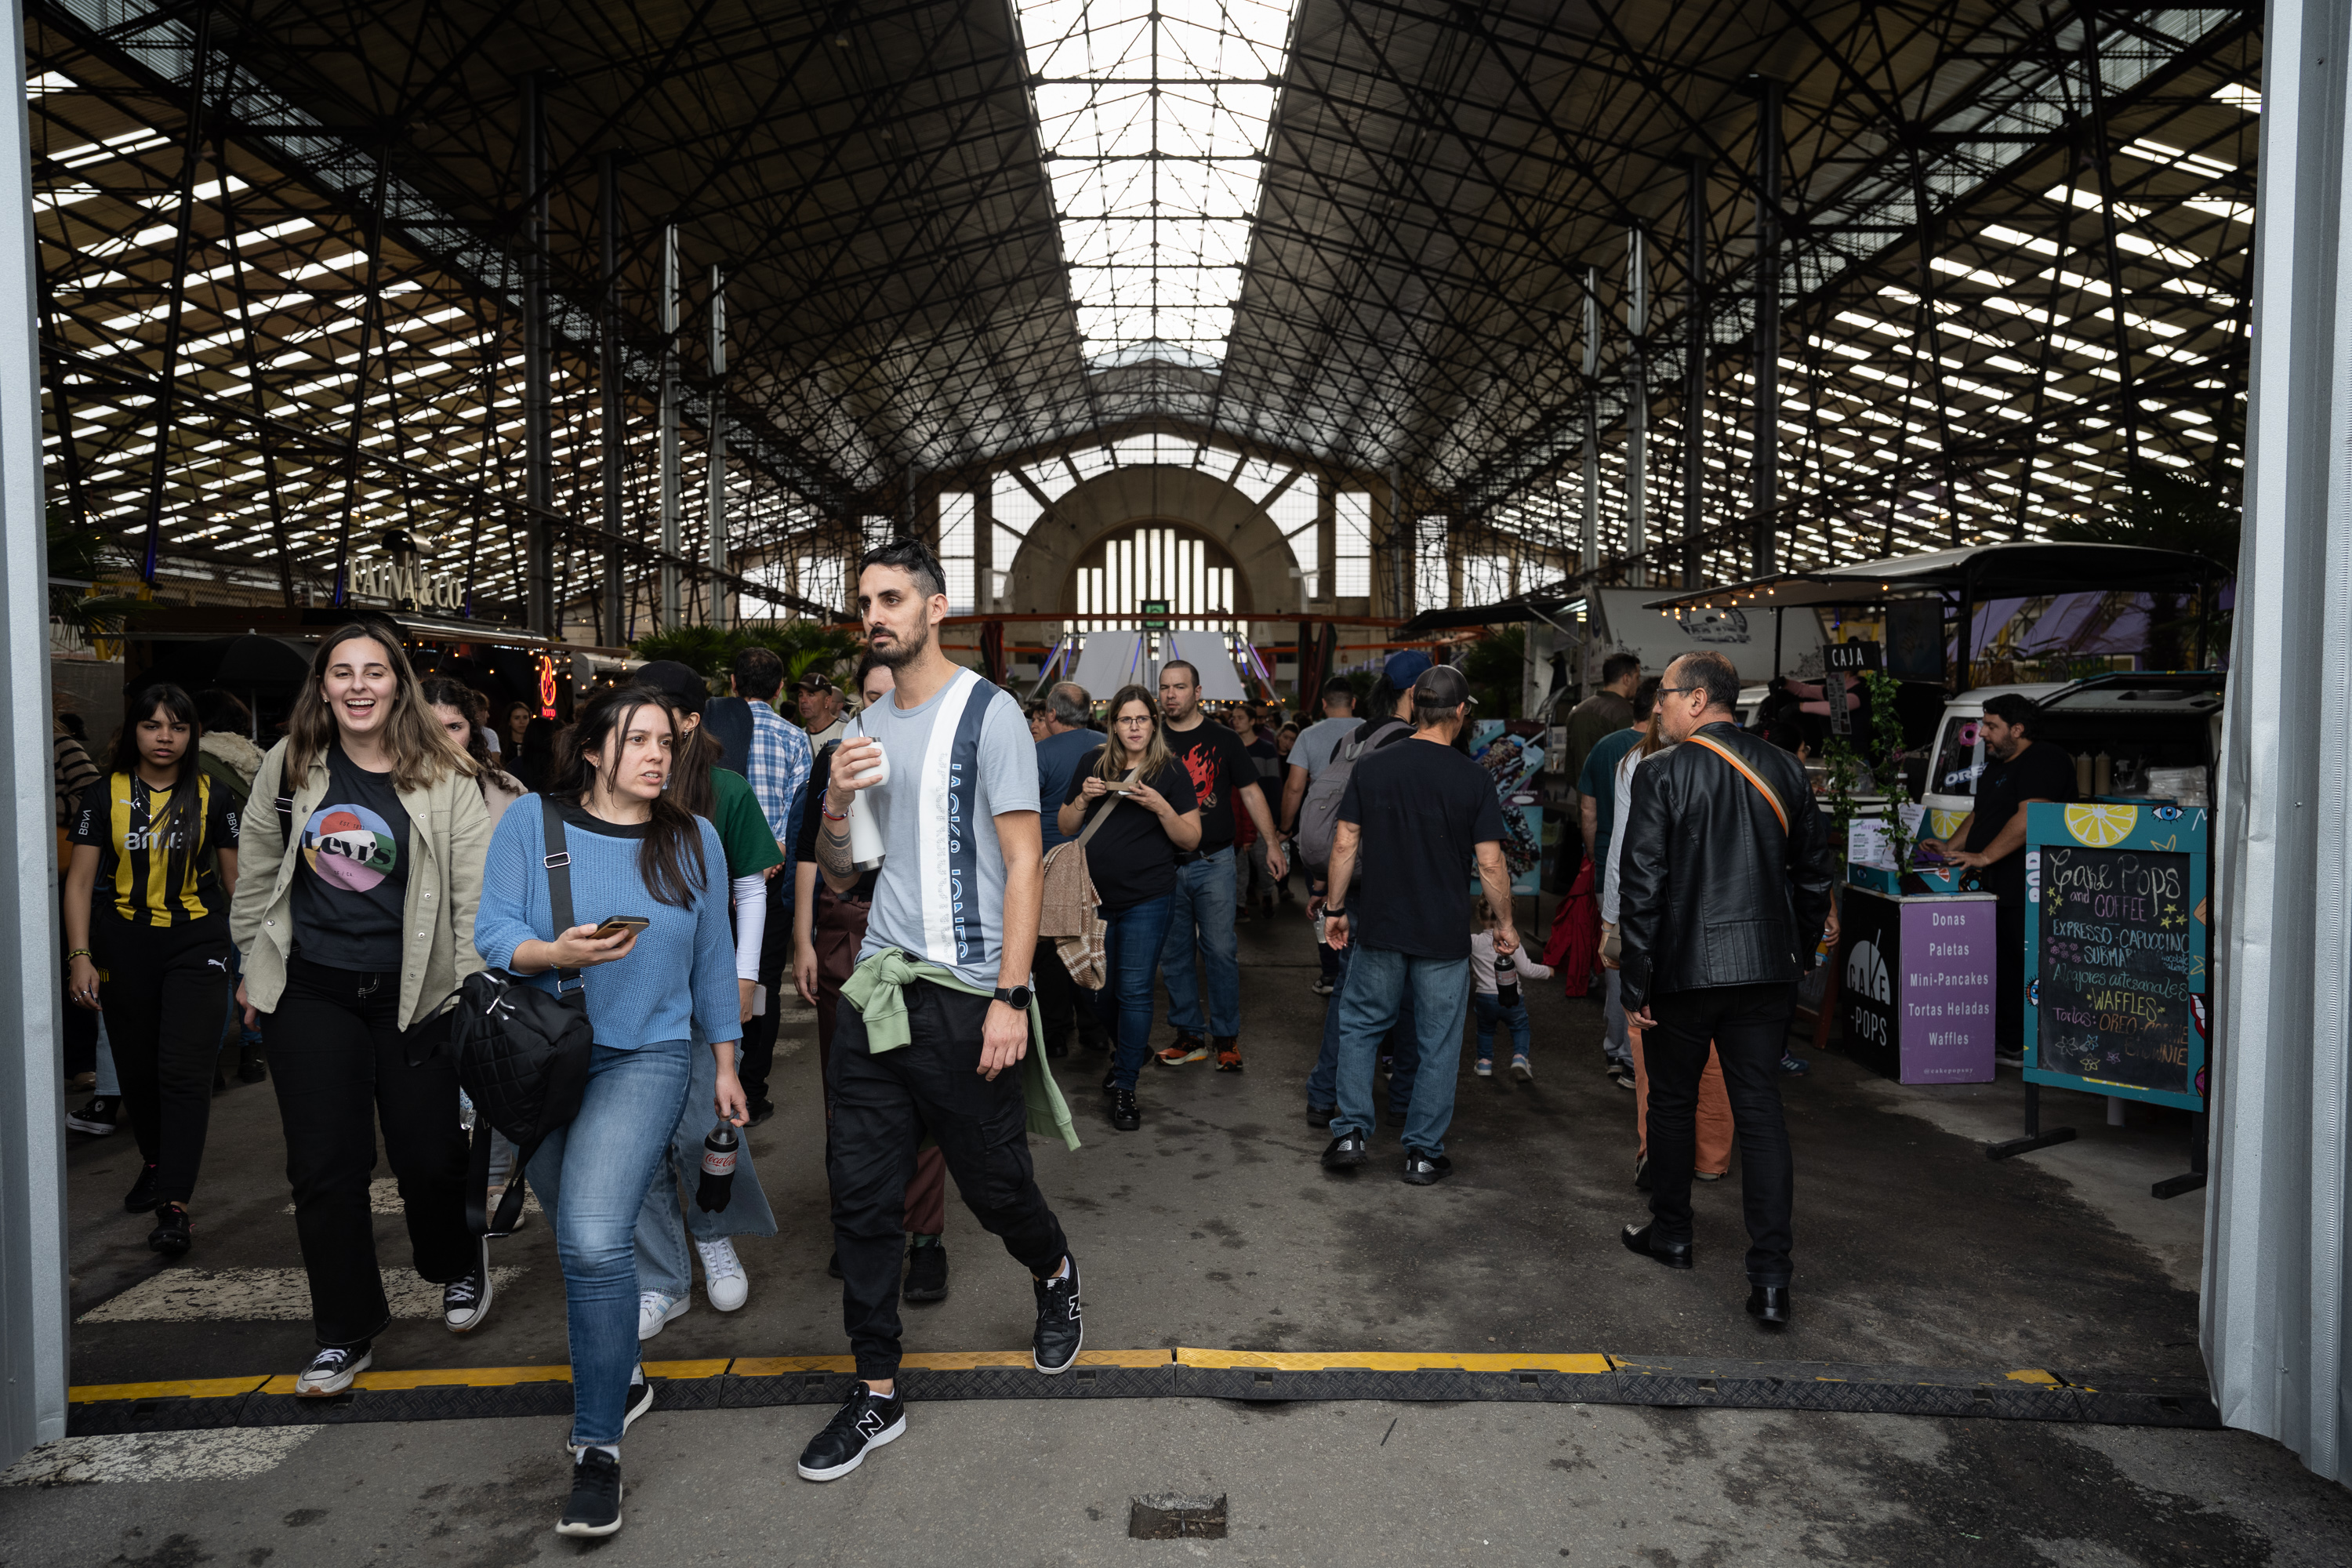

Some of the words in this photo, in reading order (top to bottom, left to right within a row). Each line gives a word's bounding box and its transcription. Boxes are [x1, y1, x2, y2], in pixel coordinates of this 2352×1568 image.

[1831, 647, 1864, 666] CAJA
[1944, 762, 1990, 787] ORE
[78, 809, 92, 836] BBVA
[304, 830, 392, 865] Levi's
[2049, 848, 2114, 894] Cake
[2118, 854, 2180, 917] Pops
[2070, 887, 2090, 904] and
[1933, 912, 1965, 927] Donas
[2094, 895, 2147, 922] COFFEE
[2053, 918, 2112, 946] EXPRESSO
[1929, 942, 1969, 956] Paletas
[1849, 947, 1888, 1005] CAKE
[1911, 972, 1989, 987] Mini-Pancakes
[1909, 1004, 1943, 1017] Tortas
[1947, 1002, 1990, 1016] Heladas
[2092, 987, 2157, 1022] WAFFLES
[2099, 1013, 2137, 1035] OREO
[1929, 1032, 1969, 1046] Waffles
